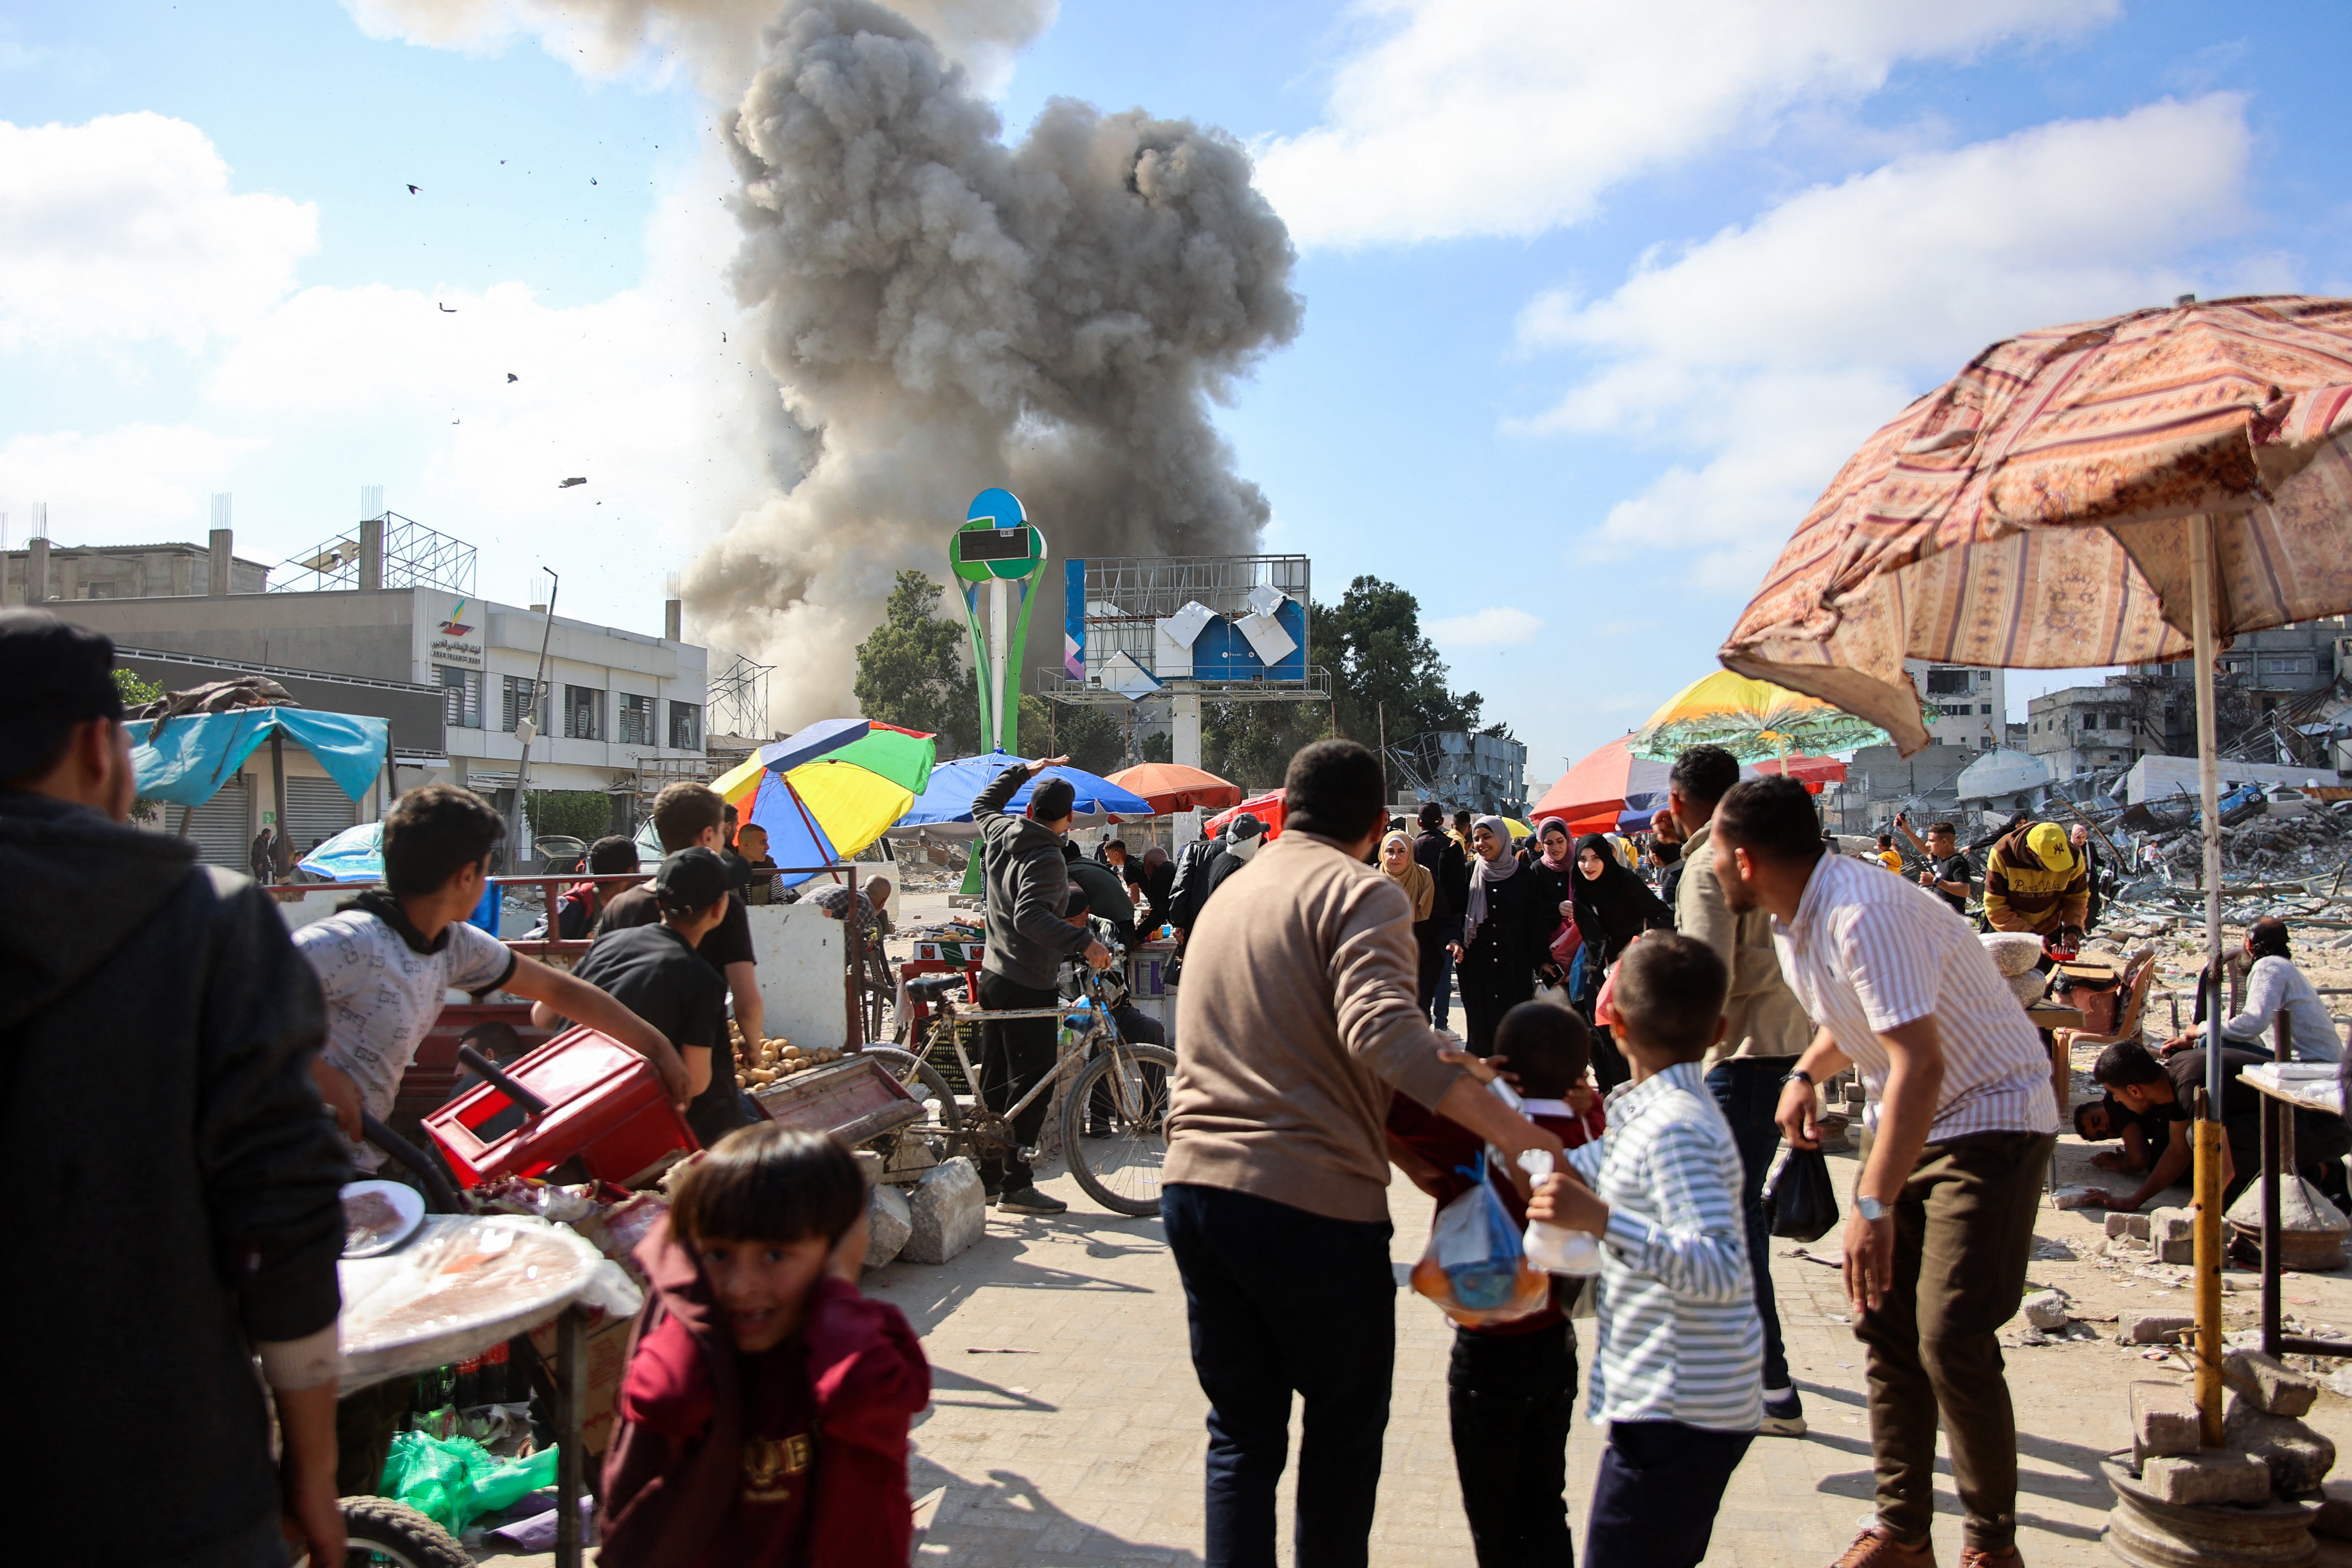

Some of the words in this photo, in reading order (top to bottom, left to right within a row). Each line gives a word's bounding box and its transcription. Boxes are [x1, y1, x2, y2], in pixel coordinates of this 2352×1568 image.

[469, 644, 481, 654] البنك
[448, 653, 467, 661] ISLAMIC
[2013, 879, 2038, 892] Pura
[2039, 880, 2061, 891] Vida
